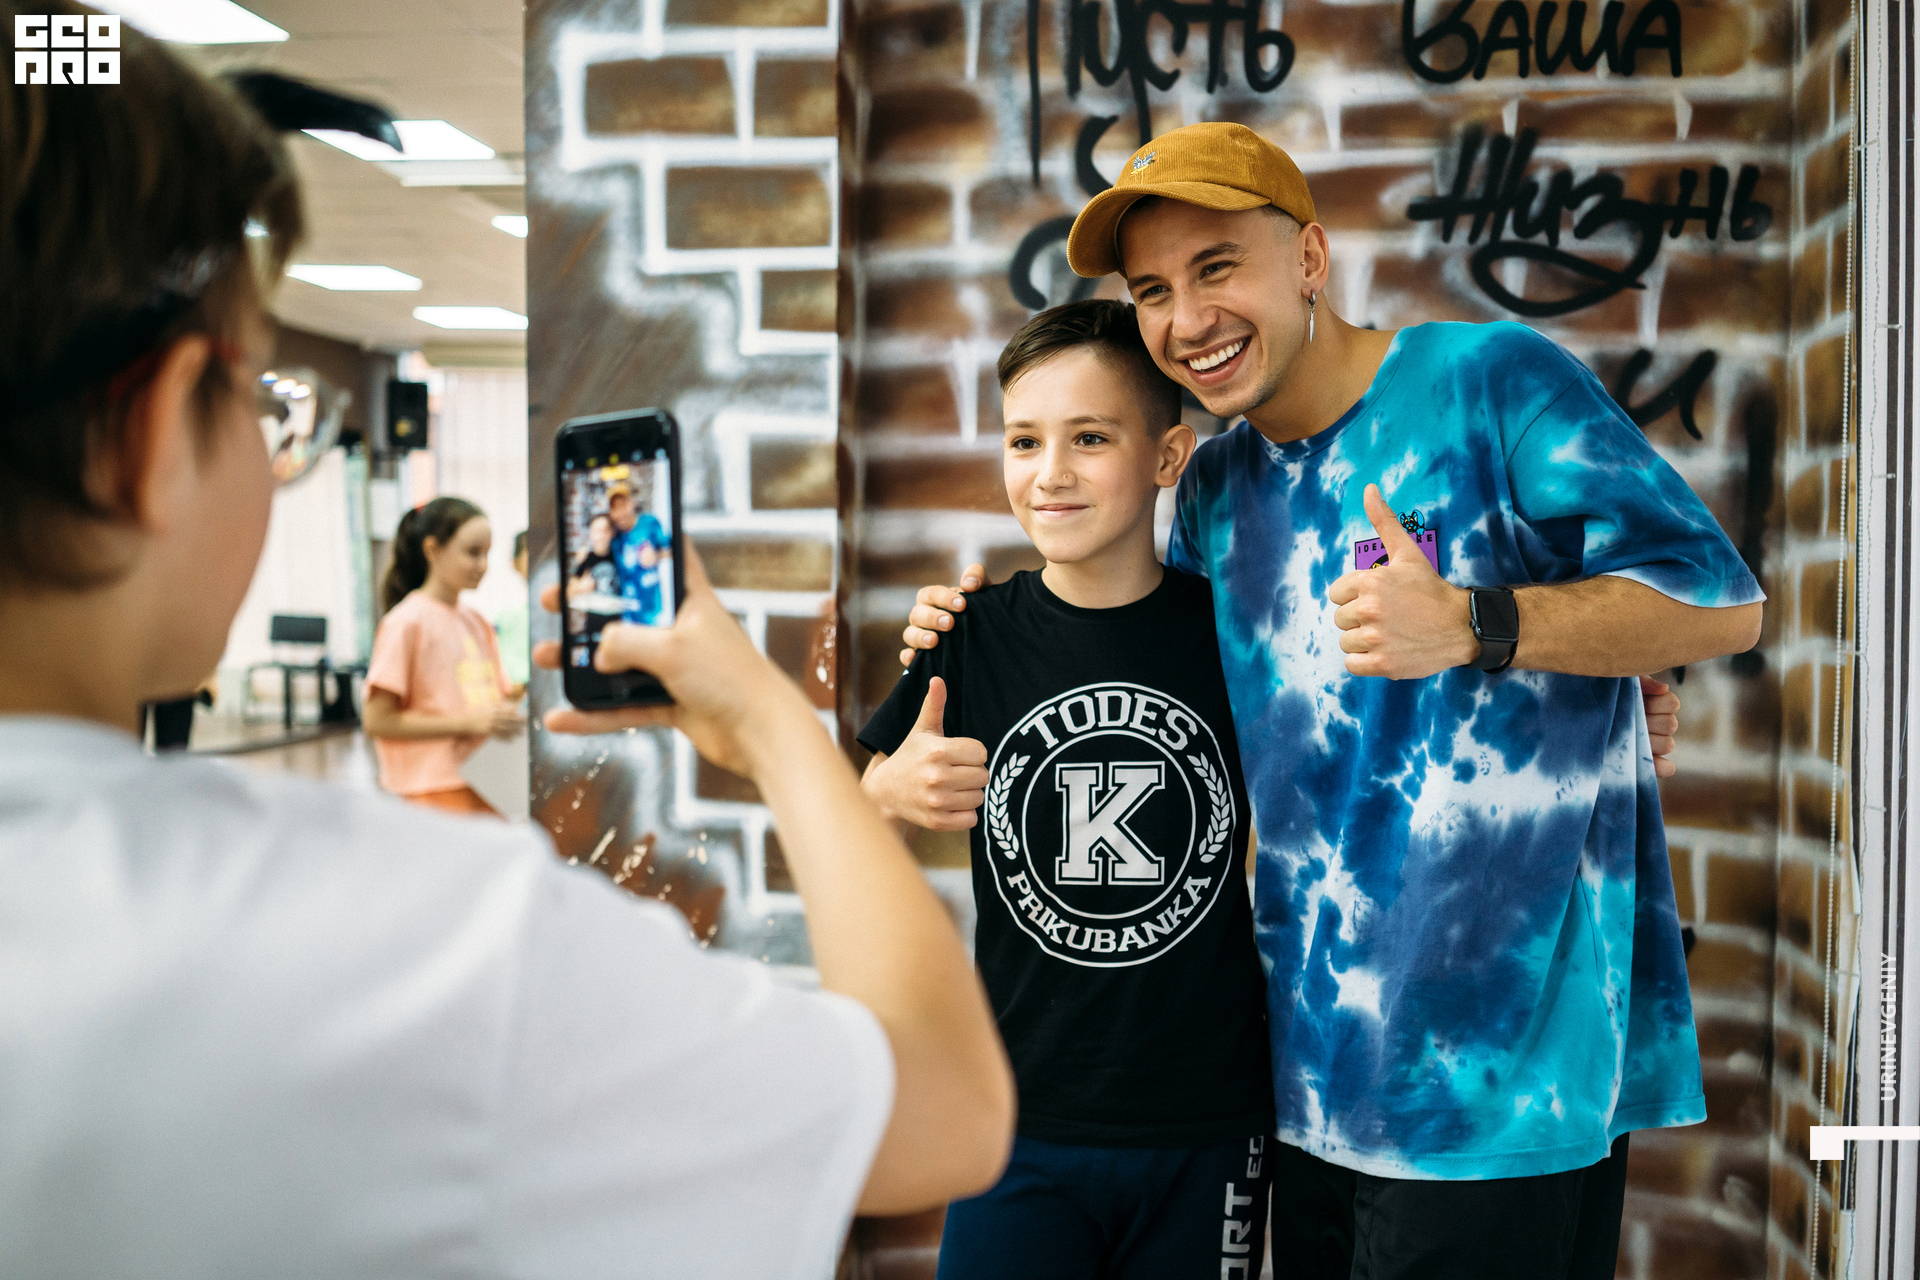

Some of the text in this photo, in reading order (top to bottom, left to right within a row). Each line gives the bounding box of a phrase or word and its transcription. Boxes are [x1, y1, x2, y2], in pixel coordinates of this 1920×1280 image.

[1019, 690, 1198, 750] TODES
[1055, 760, 1165, 886] K
[1006, 870, 1212, 953] PRIKUBANKA
